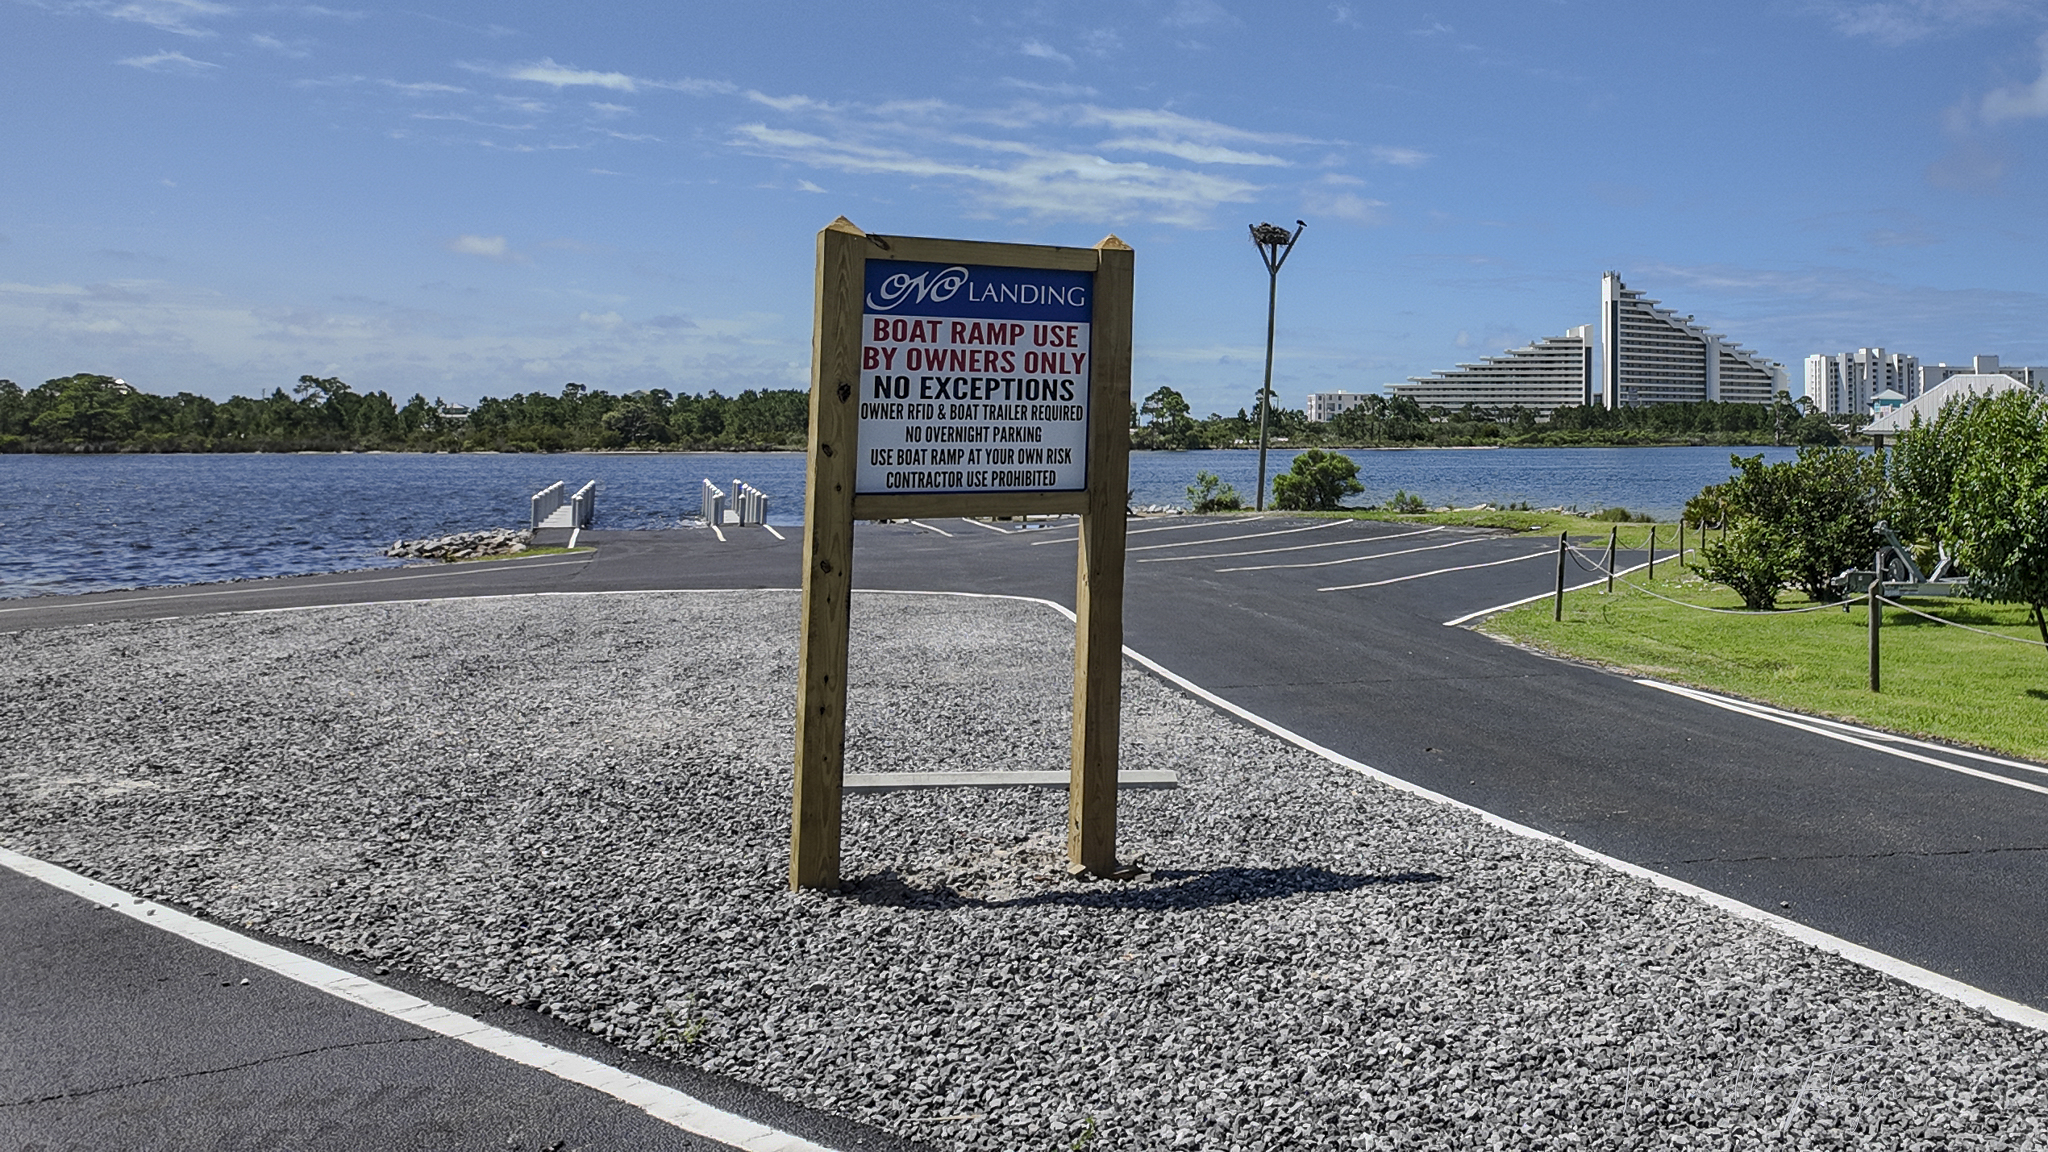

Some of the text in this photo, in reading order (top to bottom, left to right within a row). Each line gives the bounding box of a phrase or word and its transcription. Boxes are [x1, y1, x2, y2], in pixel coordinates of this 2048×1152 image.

[866, 266, 1085, 310] ONO LANDING
[873, 318, 1079, 348] BOAT RAMP USE
[863, 347, 1086, 374] BY OWNERS ONLY
[874, 376, 1075, 401] NO EXCEPTIONS
[860, 403, 1083, 422] OWNER RFID & BOAT TRAILER REQUIRED
[905, 426, 1042, 443] NO OVERNIGHT PARKING
[871, 448, 1072, 465] USE BOAT RAMP AT YOUR OWN RISK
[886, 470, 1056, 488] CONTRACTOR USE PROHIBITED
